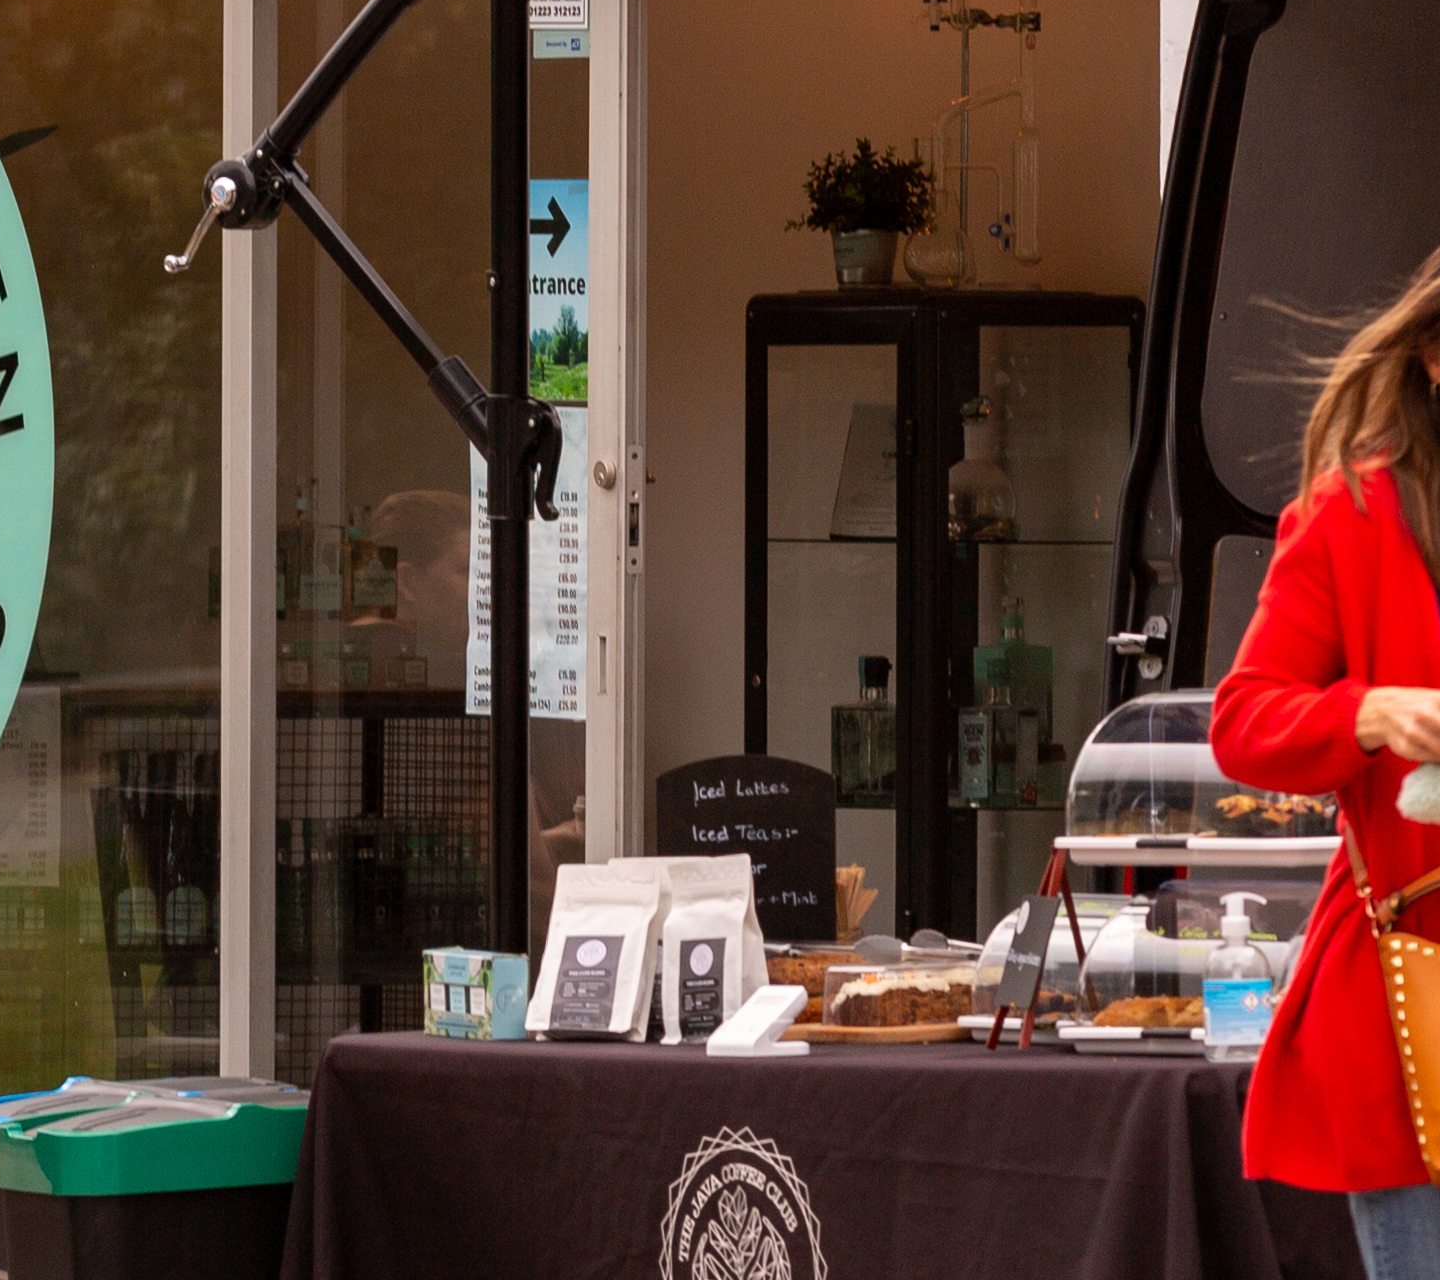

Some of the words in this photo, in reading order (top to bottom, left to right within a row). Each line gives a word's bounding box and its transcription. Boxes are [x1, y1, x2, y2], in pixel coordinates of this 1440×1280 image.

[528, 273, 587, 295] trance
[692, 779, 726, 808] Iced
[736, 778, 790, 797] Lattes
[692, 824, 729, 842] Iced
[678, 1214, 696, 1263] THE
[691, 1173, 723, 1219] JAVA
[721, 1162, 767, 1191] COFFEE
[766, 1181, 799, 1233] CLUB
